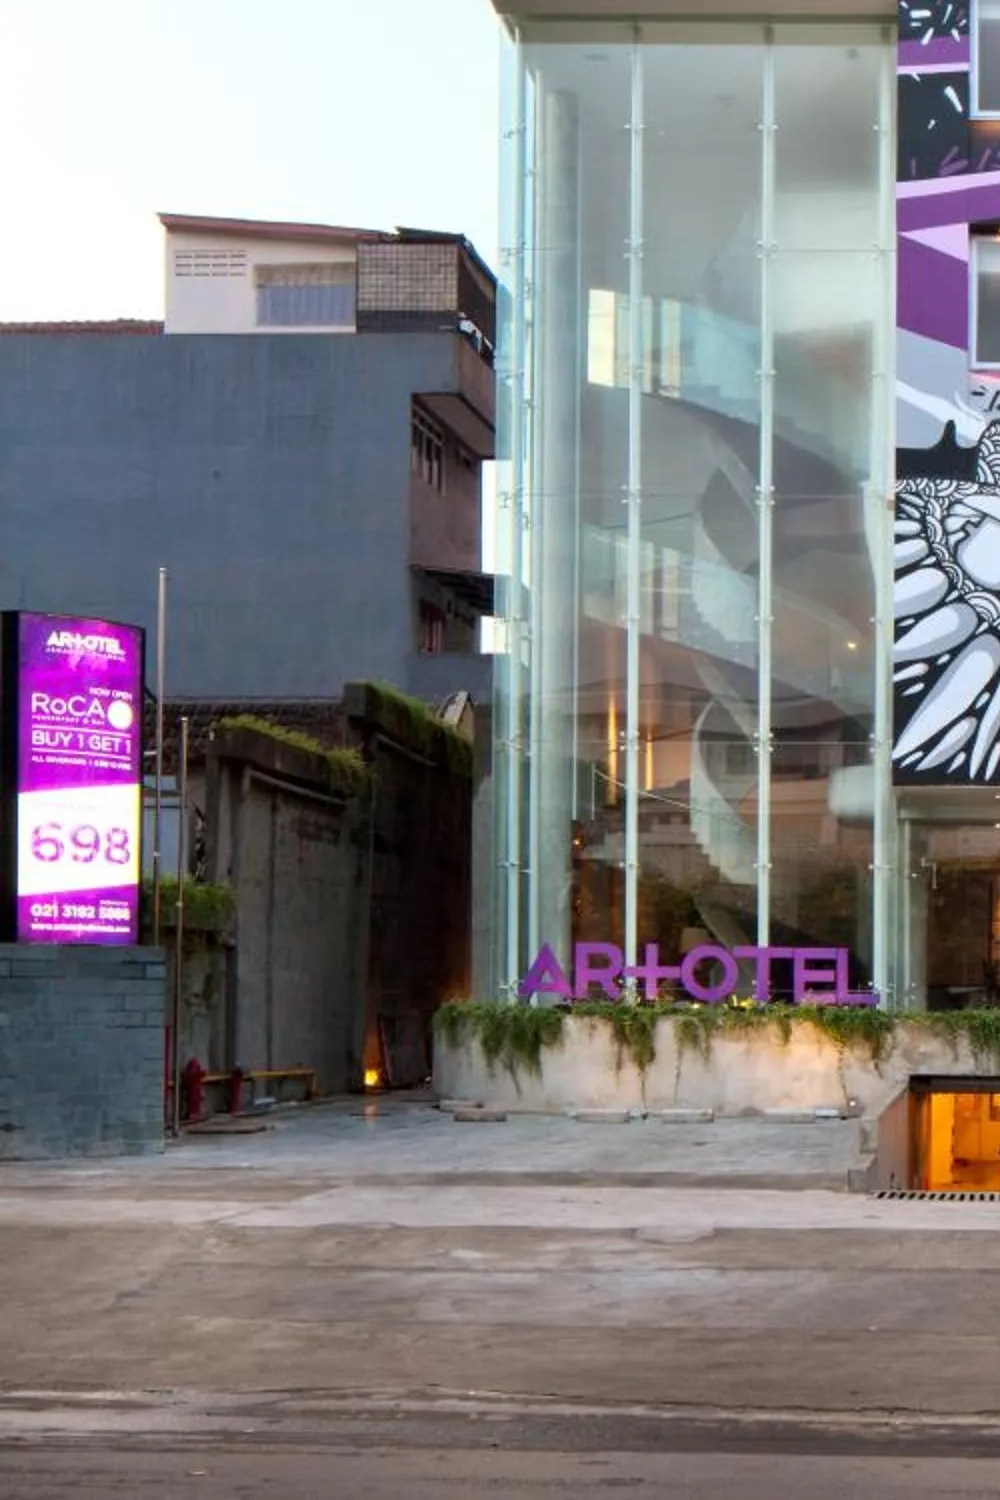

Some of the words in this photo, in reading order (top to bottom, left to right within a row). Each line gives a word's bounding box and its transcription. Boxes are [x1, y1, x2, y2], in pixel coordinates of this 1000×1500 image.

[31, 729, 73, 747] BUY
[77, 733, 84, 749] 1
[88, 735, 122, 752] GET
[125, 739, 131, 754] 1
[31, 821, 131, 865] 698
